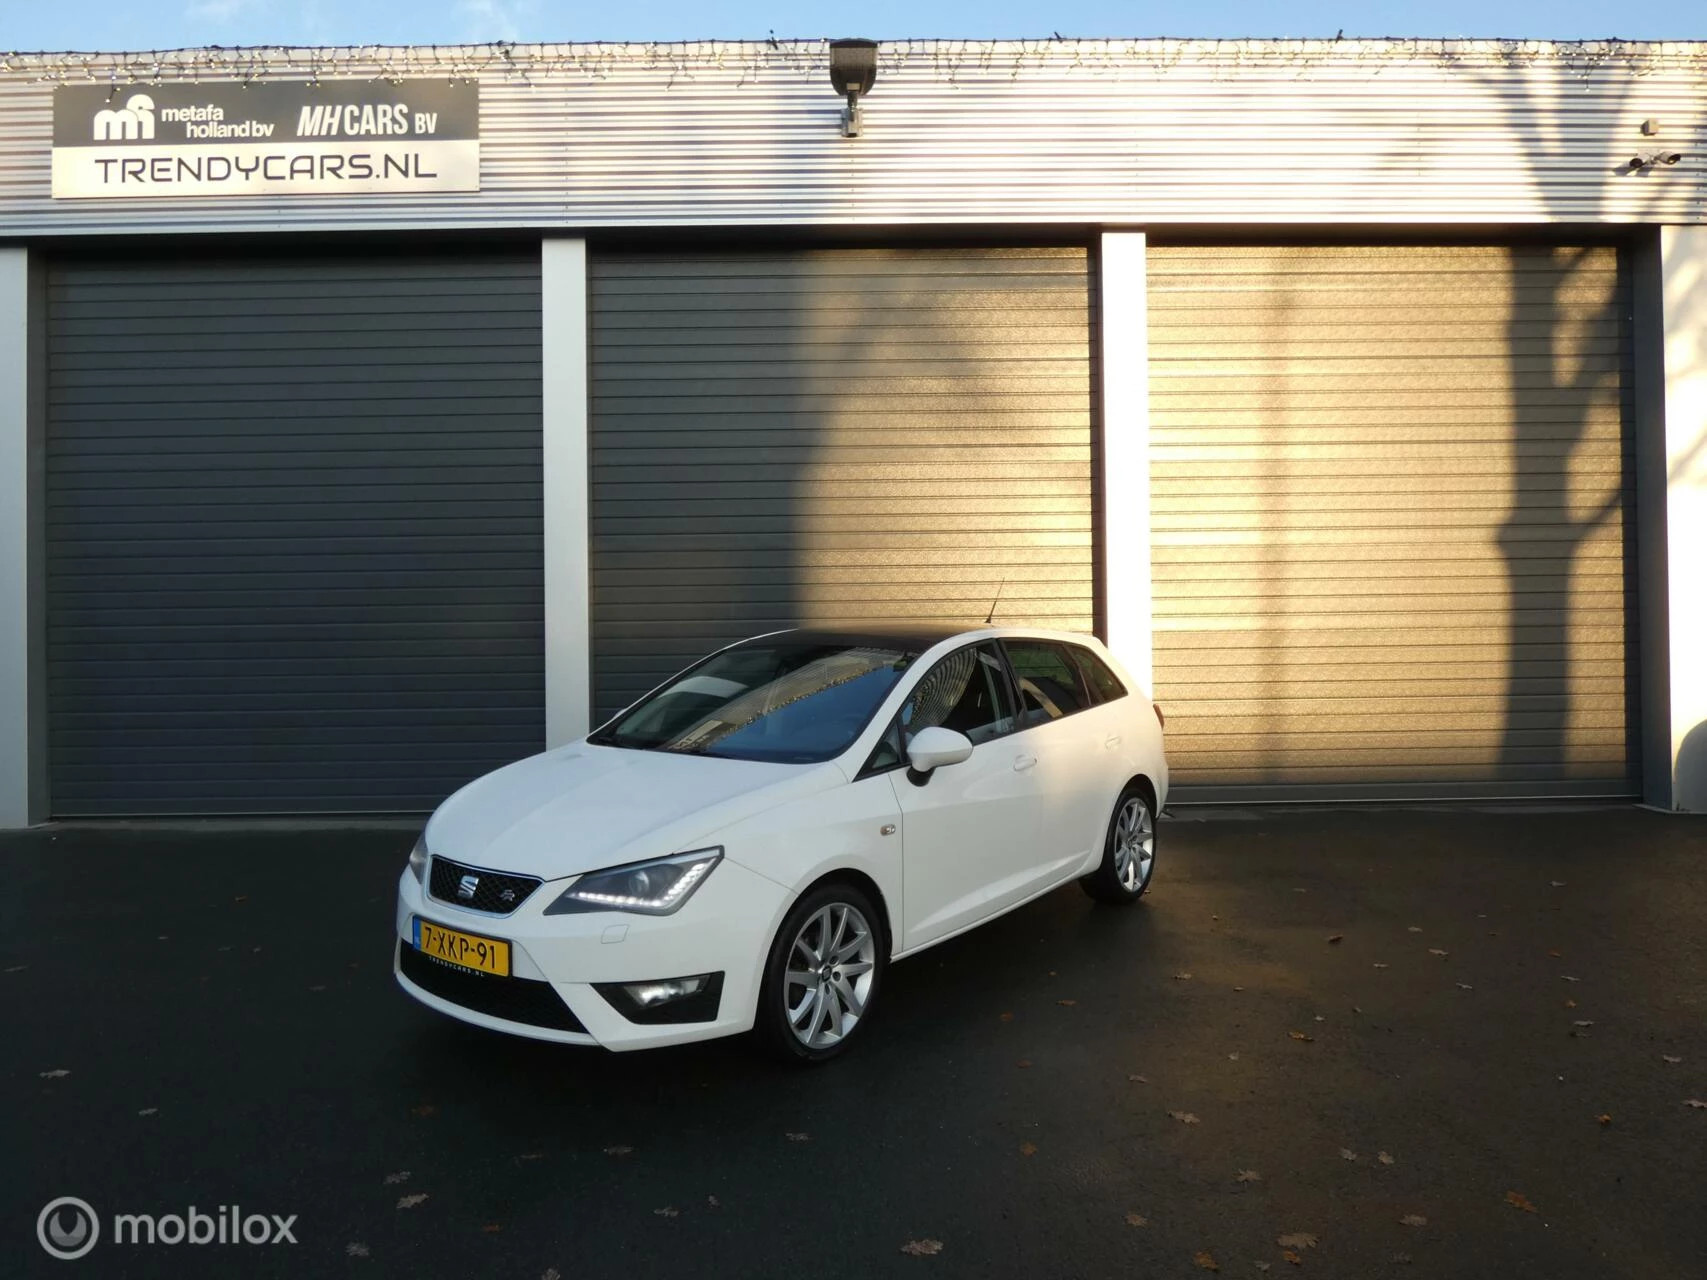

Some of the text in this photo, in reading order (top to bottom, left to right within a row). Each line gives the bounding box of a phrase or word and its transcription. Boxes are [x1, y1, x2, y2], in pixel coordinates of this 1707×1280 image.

[161, 104, 224, 122] metafa
[297, 103, 438, 136] MHCARS BV
[94, 153, 438, 184] TRENDYCARS.NL
[425, 927, 495, 969] 7-XKP-91
